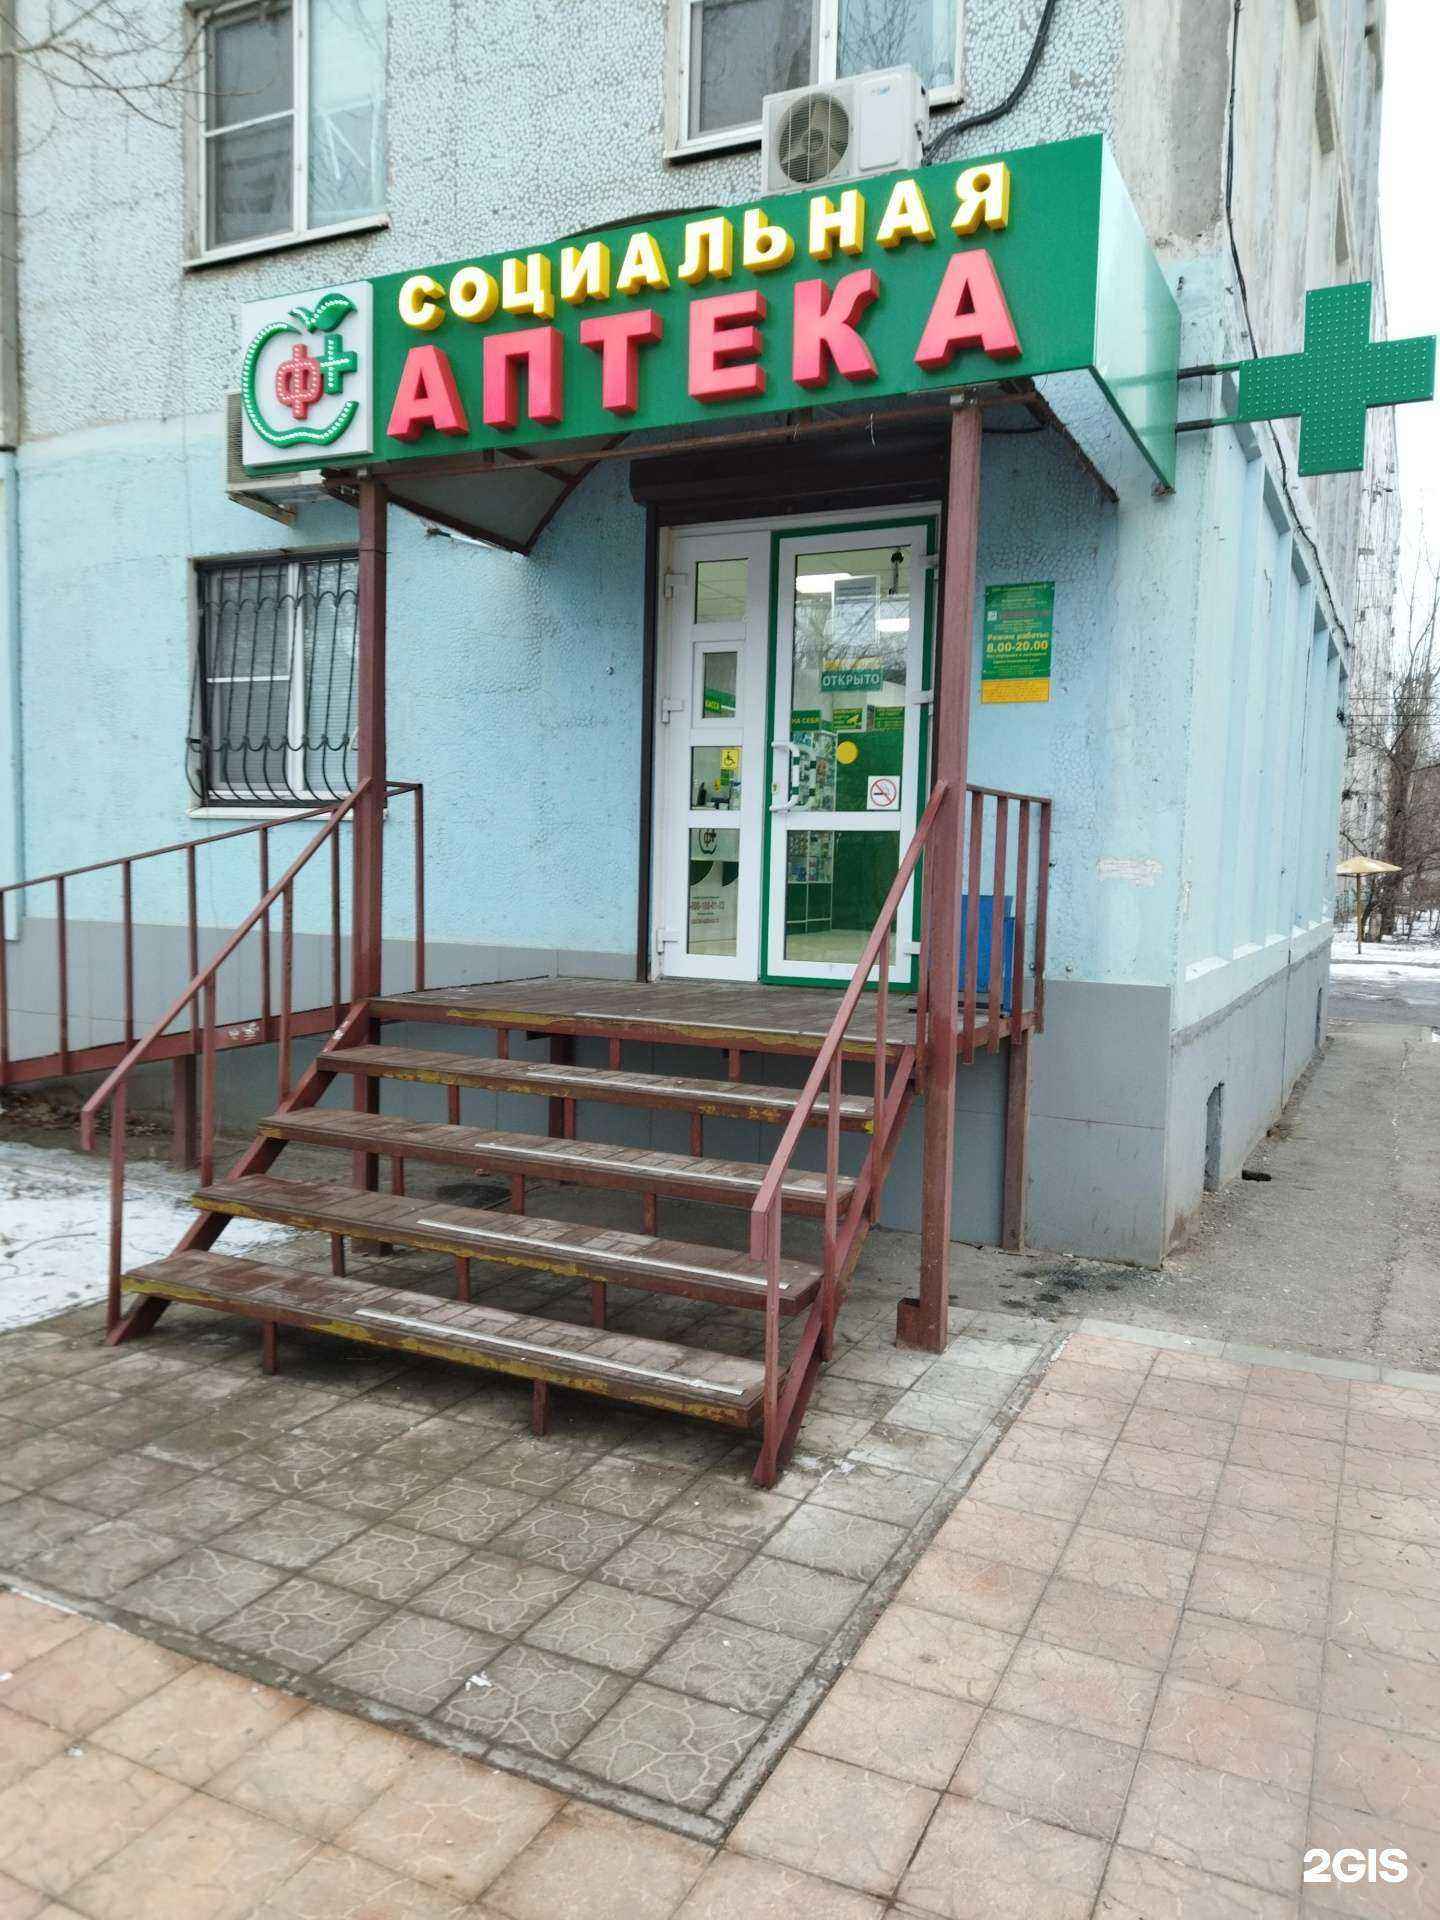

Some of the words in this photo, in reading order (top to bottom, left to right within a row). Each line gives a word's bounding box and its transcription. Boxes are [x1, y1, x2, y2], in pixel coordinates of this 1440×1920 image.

[399, 161, 1010, 331] СОЦИАЛЬНАЯ
[387, 249, 1022, 442] АПТЕКА
[823, 673, 880, 687] ОТКРЫТО
[986, 640, 1048, 653] 8.00-20.00
